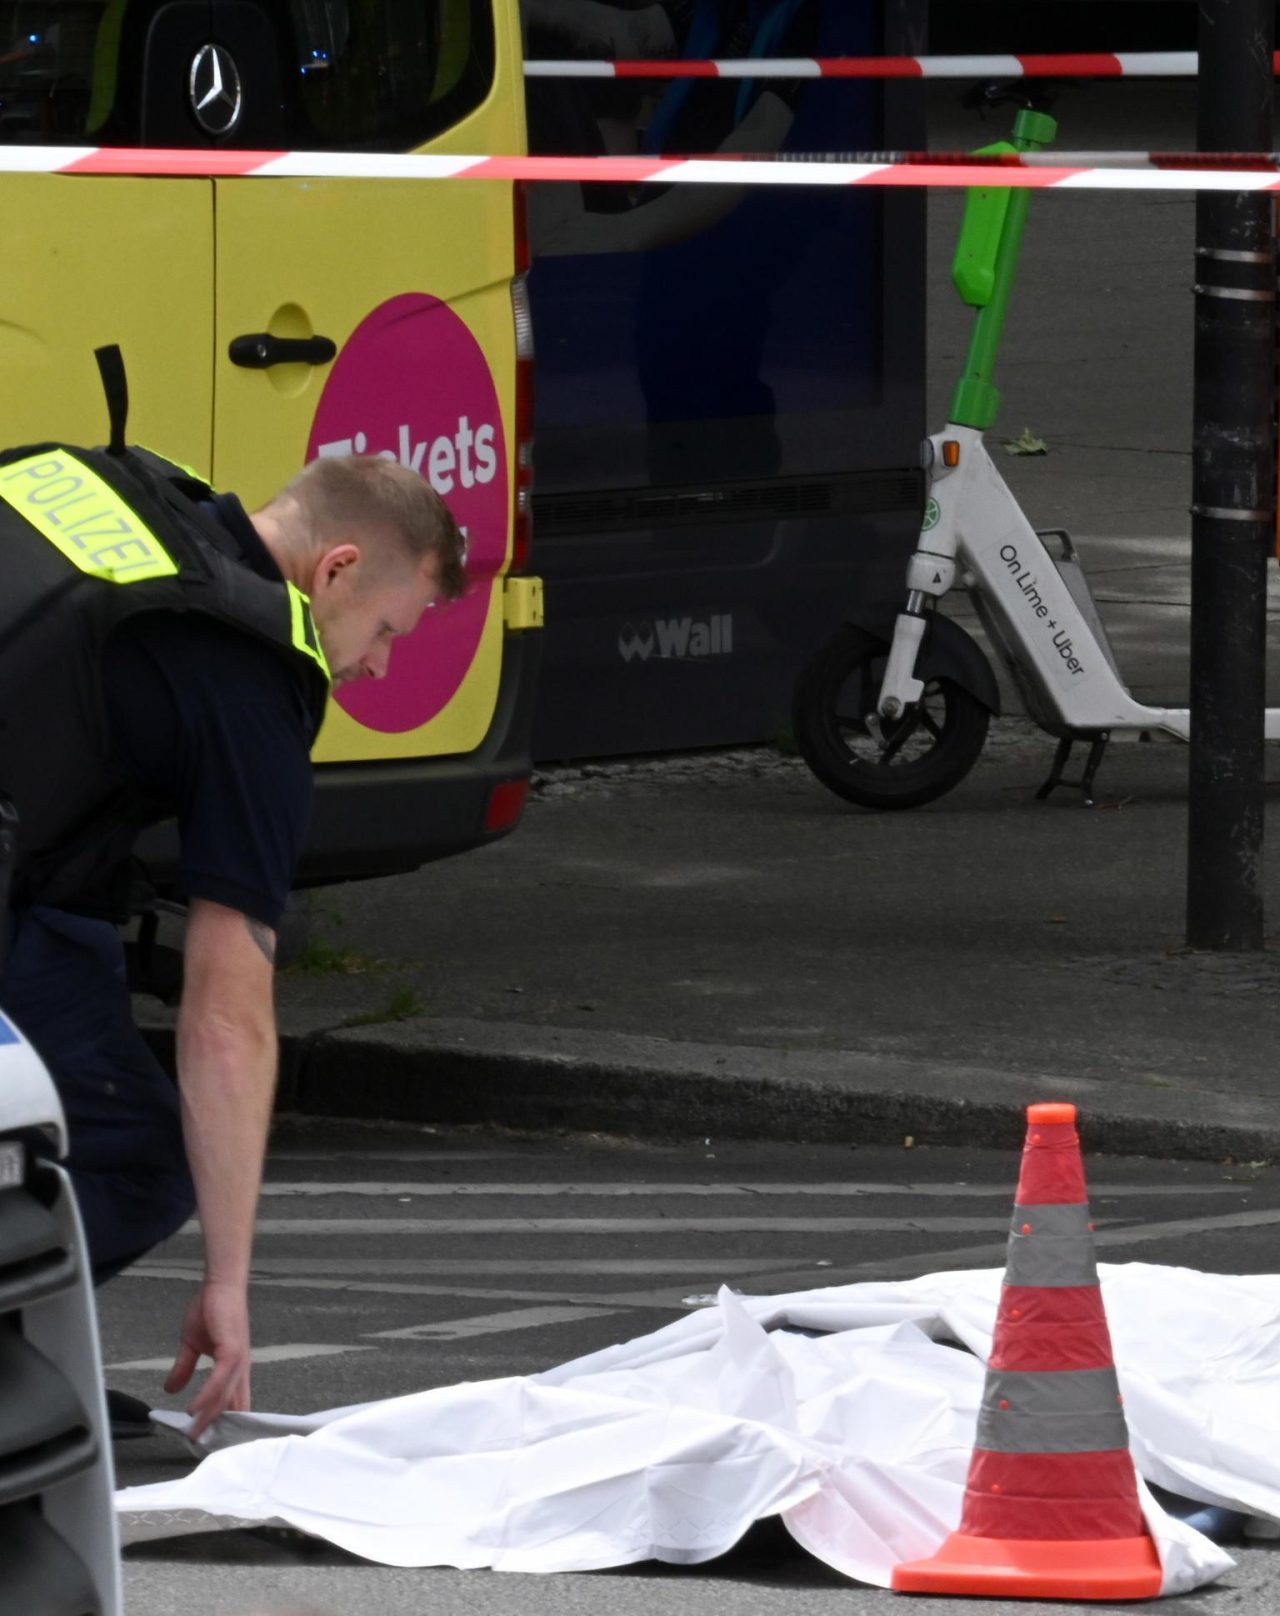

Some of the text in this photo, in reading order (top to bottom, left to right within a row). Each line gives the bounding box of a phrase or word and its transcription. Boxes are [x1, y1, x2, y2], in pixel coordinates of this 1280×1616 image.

[318, 415, 496, 495] kets
[3, 459, 160, 573] POLIZEI
[655, 613, 733, 657] Wall
[1000, 545, 1022, 575] On
[1015, 571, 1049, 619] Lime
[1052, 630, 1085, 675] Uber
